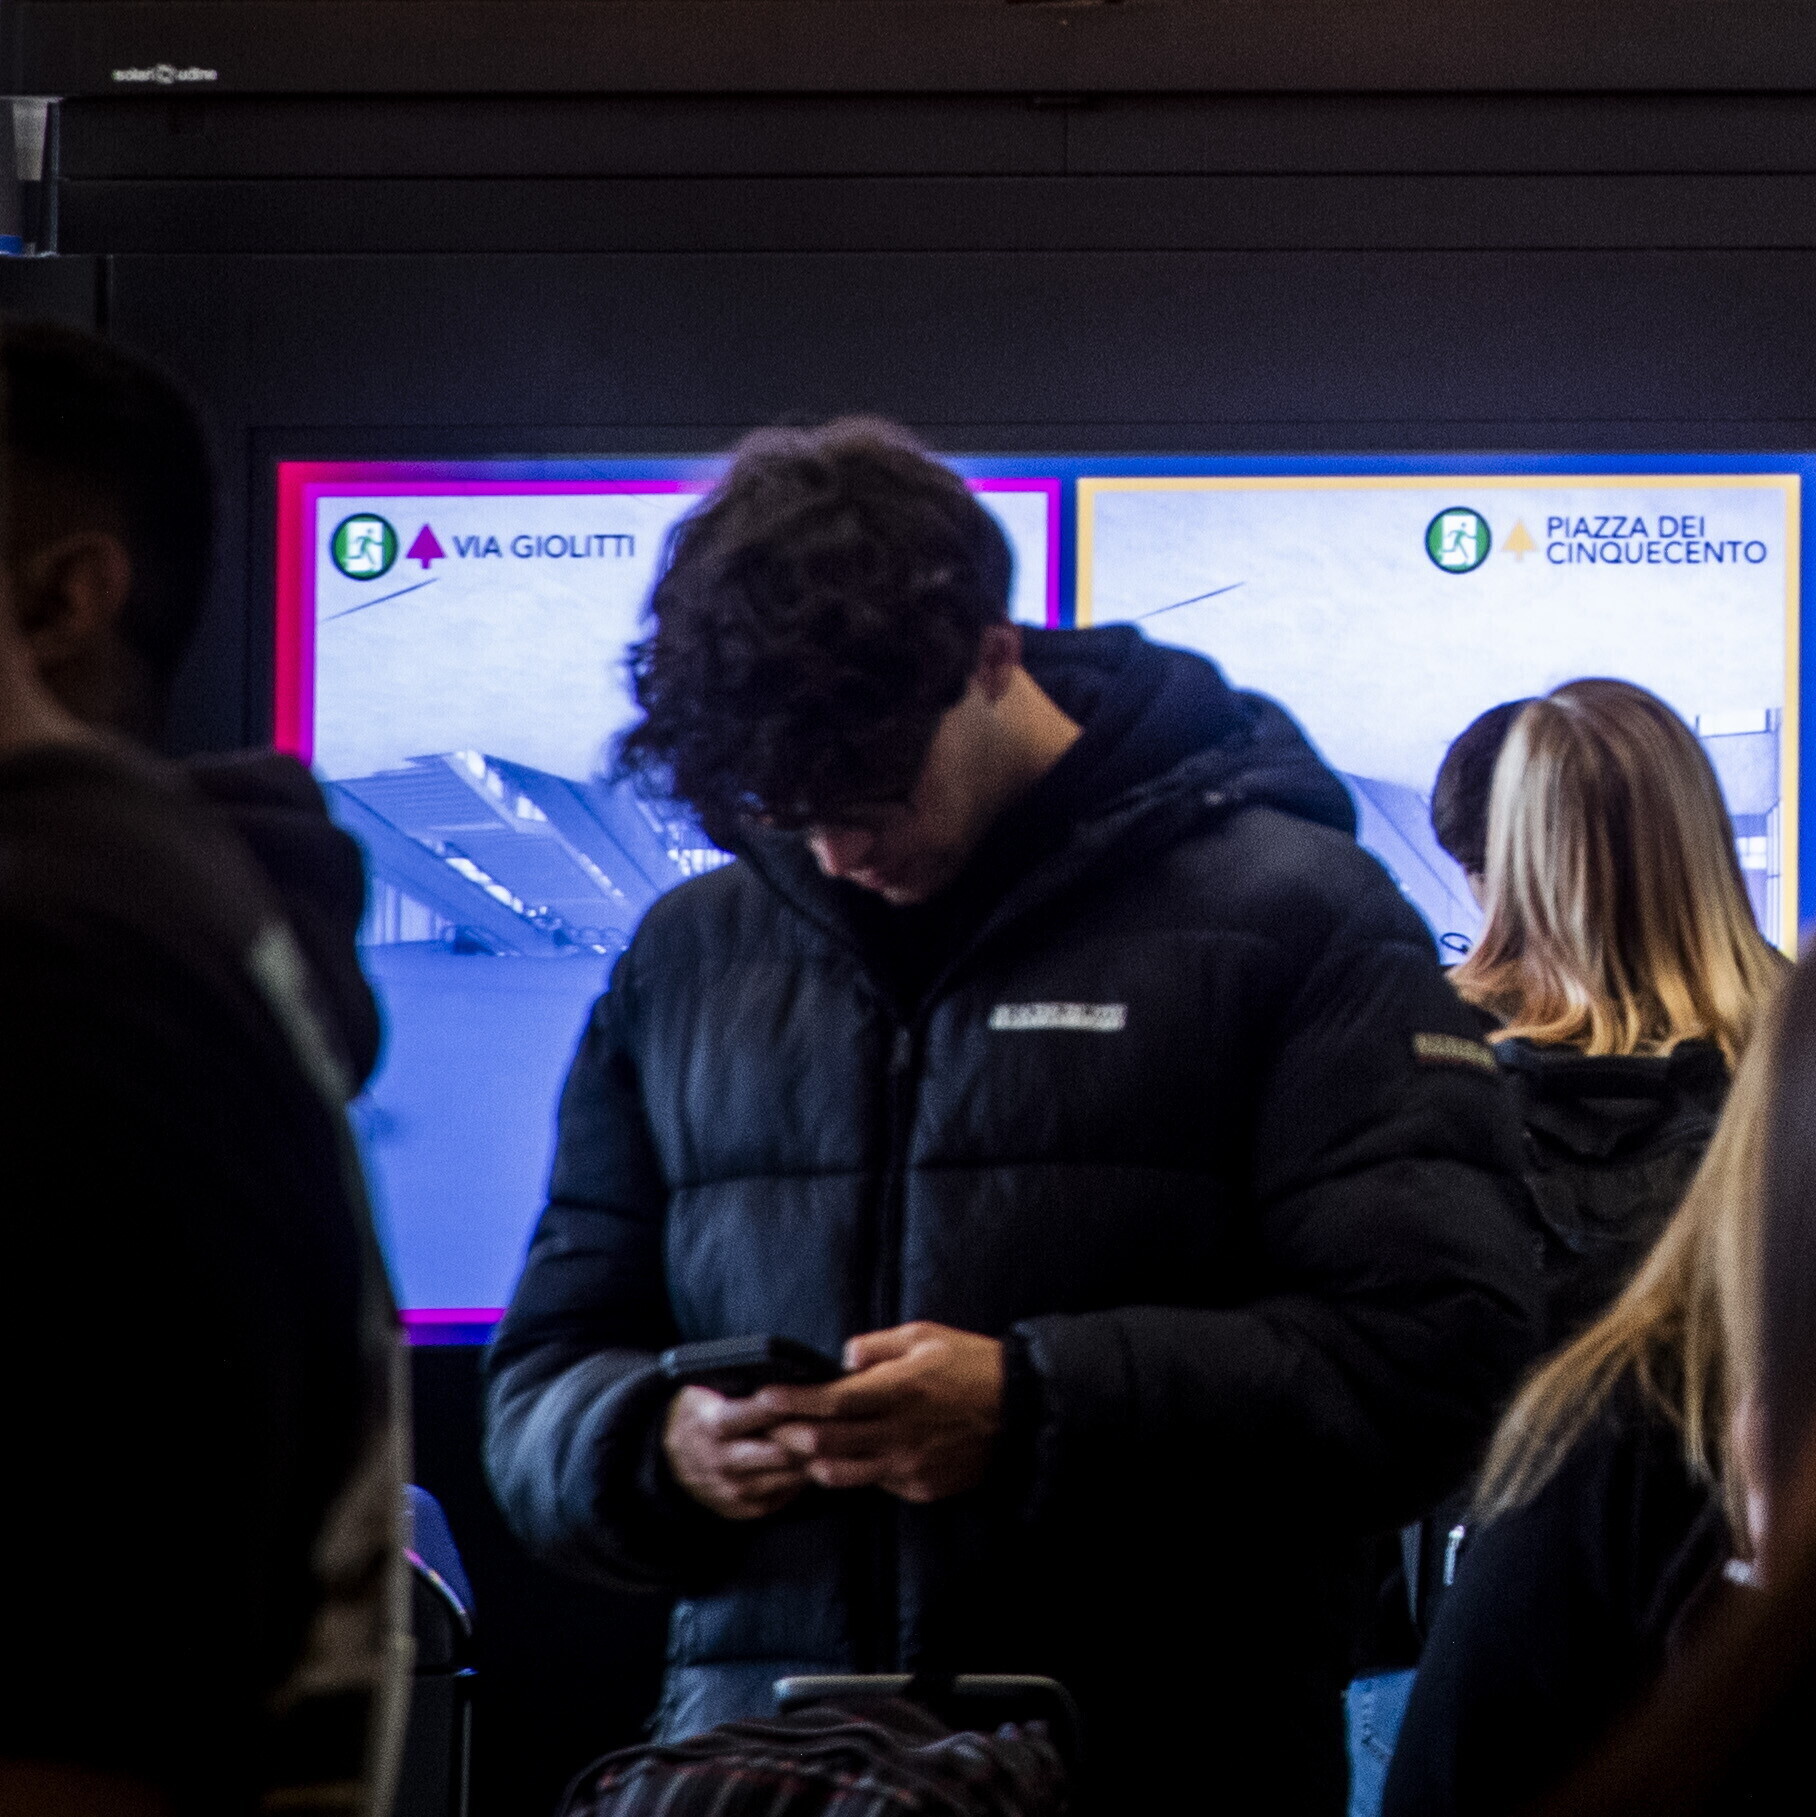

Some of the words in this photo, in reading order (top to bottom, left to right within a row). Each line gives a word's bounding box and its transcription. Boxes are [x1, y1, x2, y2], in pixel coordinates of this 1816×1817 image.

[1547, 516, 1650, 539] PIAZZA
[1658, 516, 1704, 538] DEI
[452, 535, 503, 559] VIA
[510, 534, 635, 559] GIOLITTI
[1546, 540, 1768, 565] CINQUECENTO
